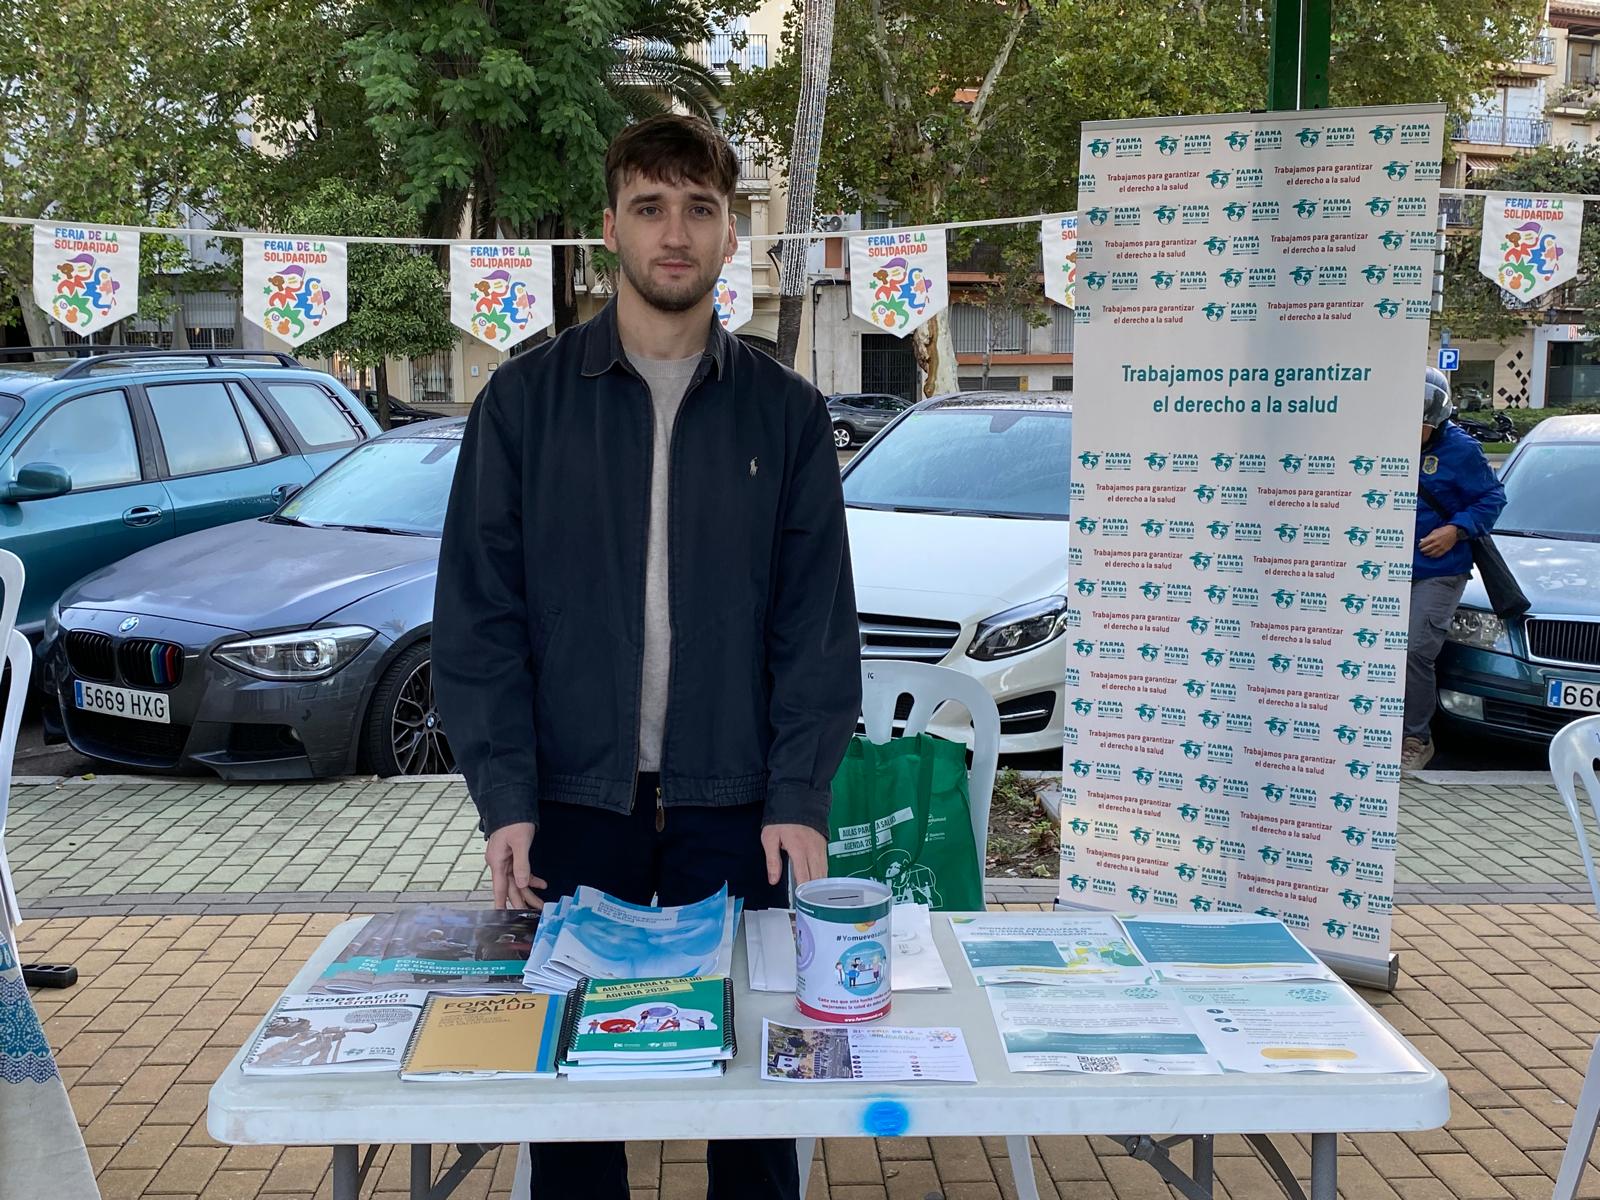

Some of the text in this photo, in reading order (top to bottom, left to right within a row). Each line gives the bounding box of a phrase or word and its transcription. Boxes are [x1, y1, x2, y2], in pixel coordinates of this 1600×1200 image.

[1274, 164, 1373, 174] Trabajamos para garantizar
[1107, 170, 1199, 182] Trabajamos para garantizar
[1294, 176, 1323, 185] derecho
[1339, 175, 1360, 183] salud
[1126, 184, 1154, 192] derecho
[1168, 182, 1188, 190] salud
[1505, 198, 1563, 209] FERIA DE LA
[1504, 209, 1563, 220] SOLIDARIDAD
[56, 228, 117, 241] FERIA DE LA
[868, 234, 926, 246] FERIA DE LA
[55, 240, 119, 253] SOLIDARIDAD
[264, 241, 325, 252] FERIA DE LA
[471, 247, 530, 257] FERIA DE LA
[868, 244, 928, 256] SOLIDARIDAD
[264, 252, 327, 264] SOLIDARIDAD
[470, 257, 532, 268] SOLIDARIDAD
[1180, 270, 1206, 278] FARMA
[1319, 265, 1346, 273] FARMA
[1102, 304, 1194, 314] Trabajamos para garantizar
[1113, 316, 1120, 324] el
[1155, 315, 1162, 323] la
[1163, 315, 1183, 323] salud
[1442, 352, 1455, 368] P
[1121, 363, 1371, 386] Trabajamos para garantizar
[1153, 395, 1337, 413] el derecho a la salud
[1257, 486, 1352, 498] Trabajamos para garantizar
[1276, 499, 1305, 507] derecho
[1371, 595, 1400, 604] FARMA
[86, 687, 164, 718] 5669 HXG
[1243, 746, 1281, 758] Trabajamos
[1300, 755, 1336, 764] garantizar
[1262, 760, 1290, 770] derecho
[1305, 766, 1324, 775] salud
[843, 828, 857, 837] AULAS
[881, 816, 896, 828] SALUD
[844, 840, 865, 850] AGENDA
[1085, 847, 1120, 858] Trabajamos
[1136, 857, 1168, 866] garantizar
[1103, 861, 1128, 870] derecho
[1141, 868, 1158, 876] salud
[1352, 923, 1379, 933] FARMA
[1352, 930, 1379, 939] MUNDI
[602, 984, 632, 992] AULAS
[606, 990, 642, 999] AGENDA
[444, 998, 520, 1009] FORMA
[464, 1003, 535, 1013] SALUD
